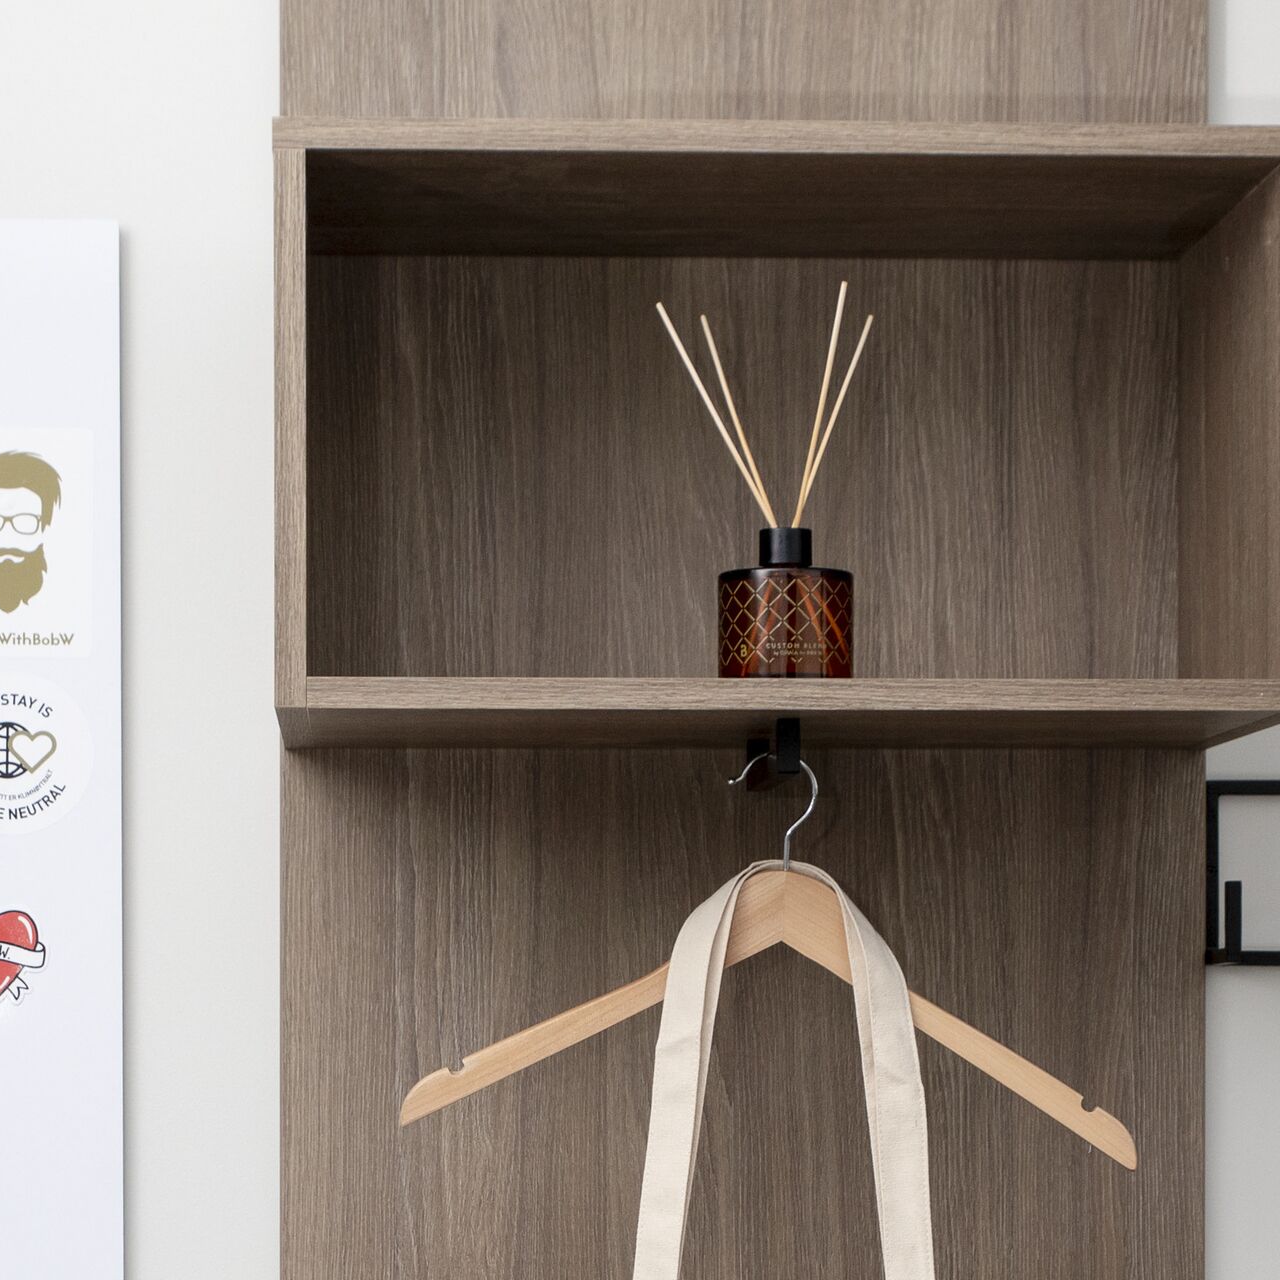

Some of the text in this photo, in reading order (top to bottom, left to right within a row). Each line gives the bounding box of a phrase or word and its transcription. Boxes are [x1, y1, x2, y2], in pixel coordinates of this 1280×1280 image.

[765, 642, 800, 650] CUSTOM
[0, 693, 38, 710] STAY
[37, 702, 54, 719] IS
[8, 784, 66, 820] NEUTRAL
